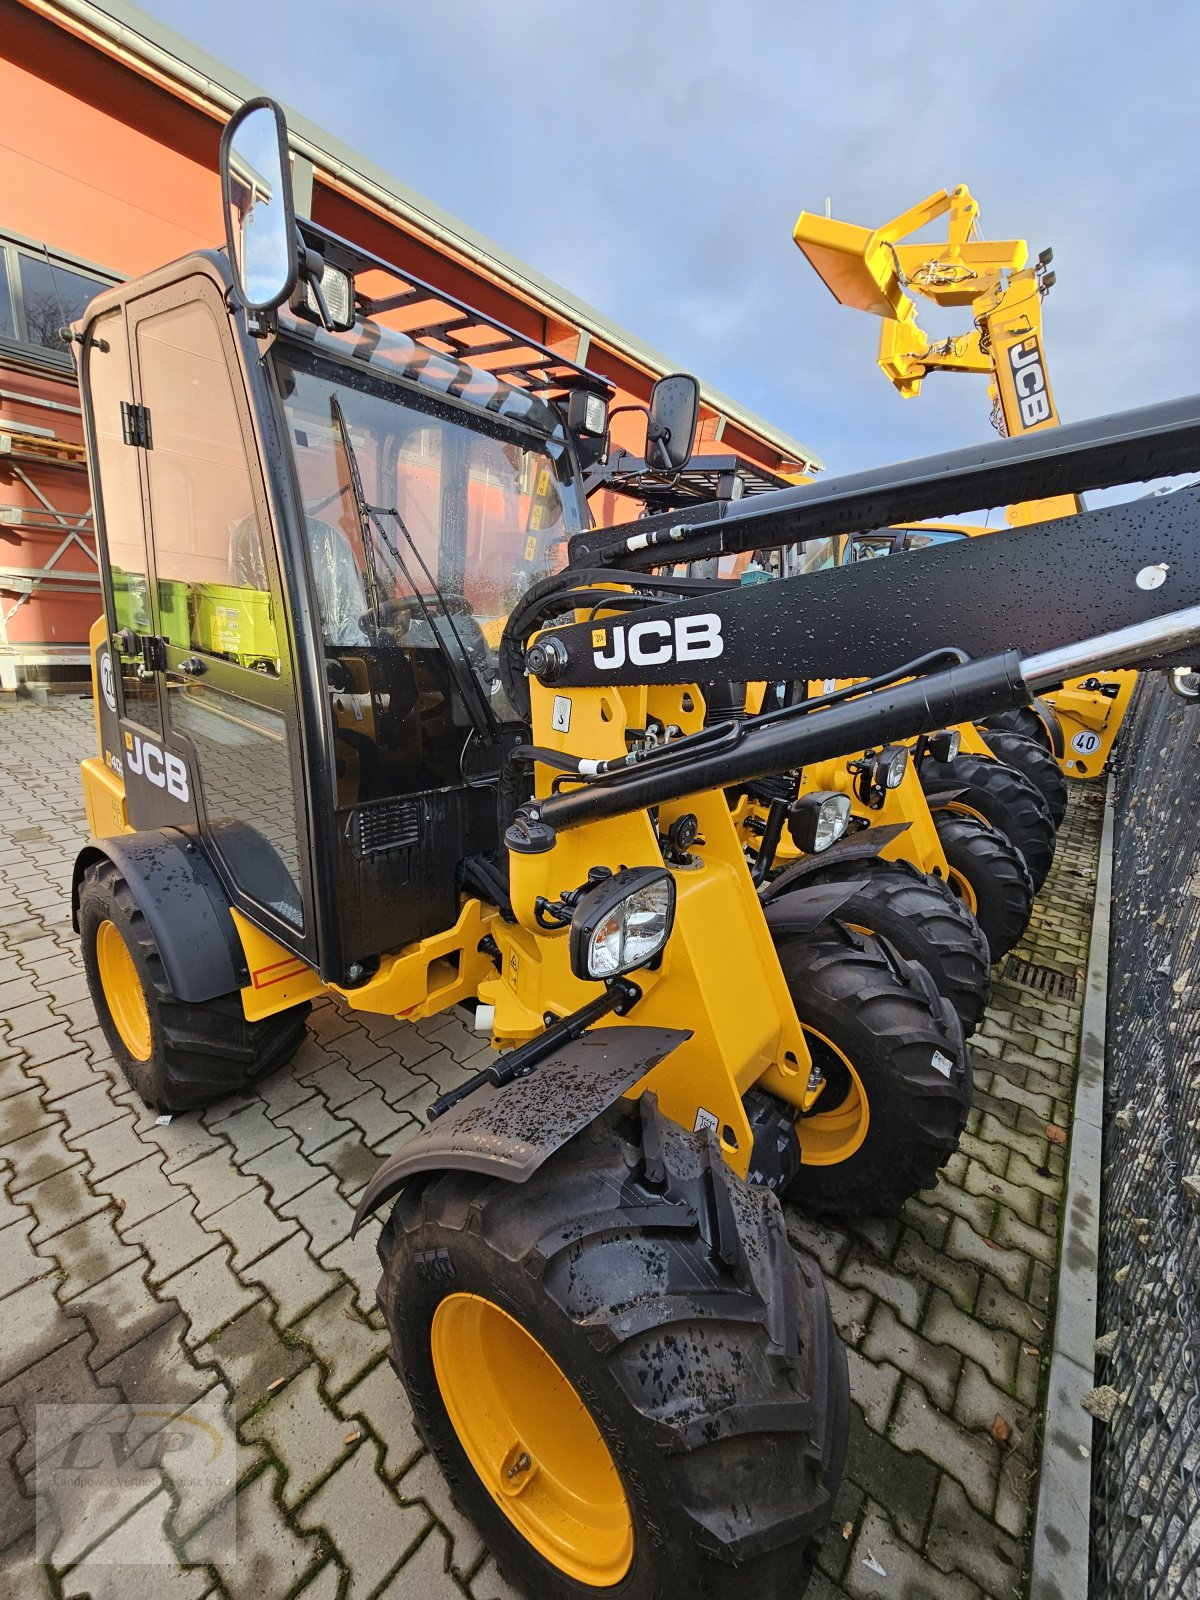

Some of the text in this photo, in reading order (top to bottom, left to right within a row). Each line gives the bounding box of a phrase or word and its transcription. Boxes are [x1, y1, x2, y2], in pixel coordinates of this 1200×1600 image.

[1011, 343, 1050, 426] JCB
[594, 613, 724, 670] JCB
[126, 735, 190, 803] JCB
[1077, 735, 1096, 750] 40
